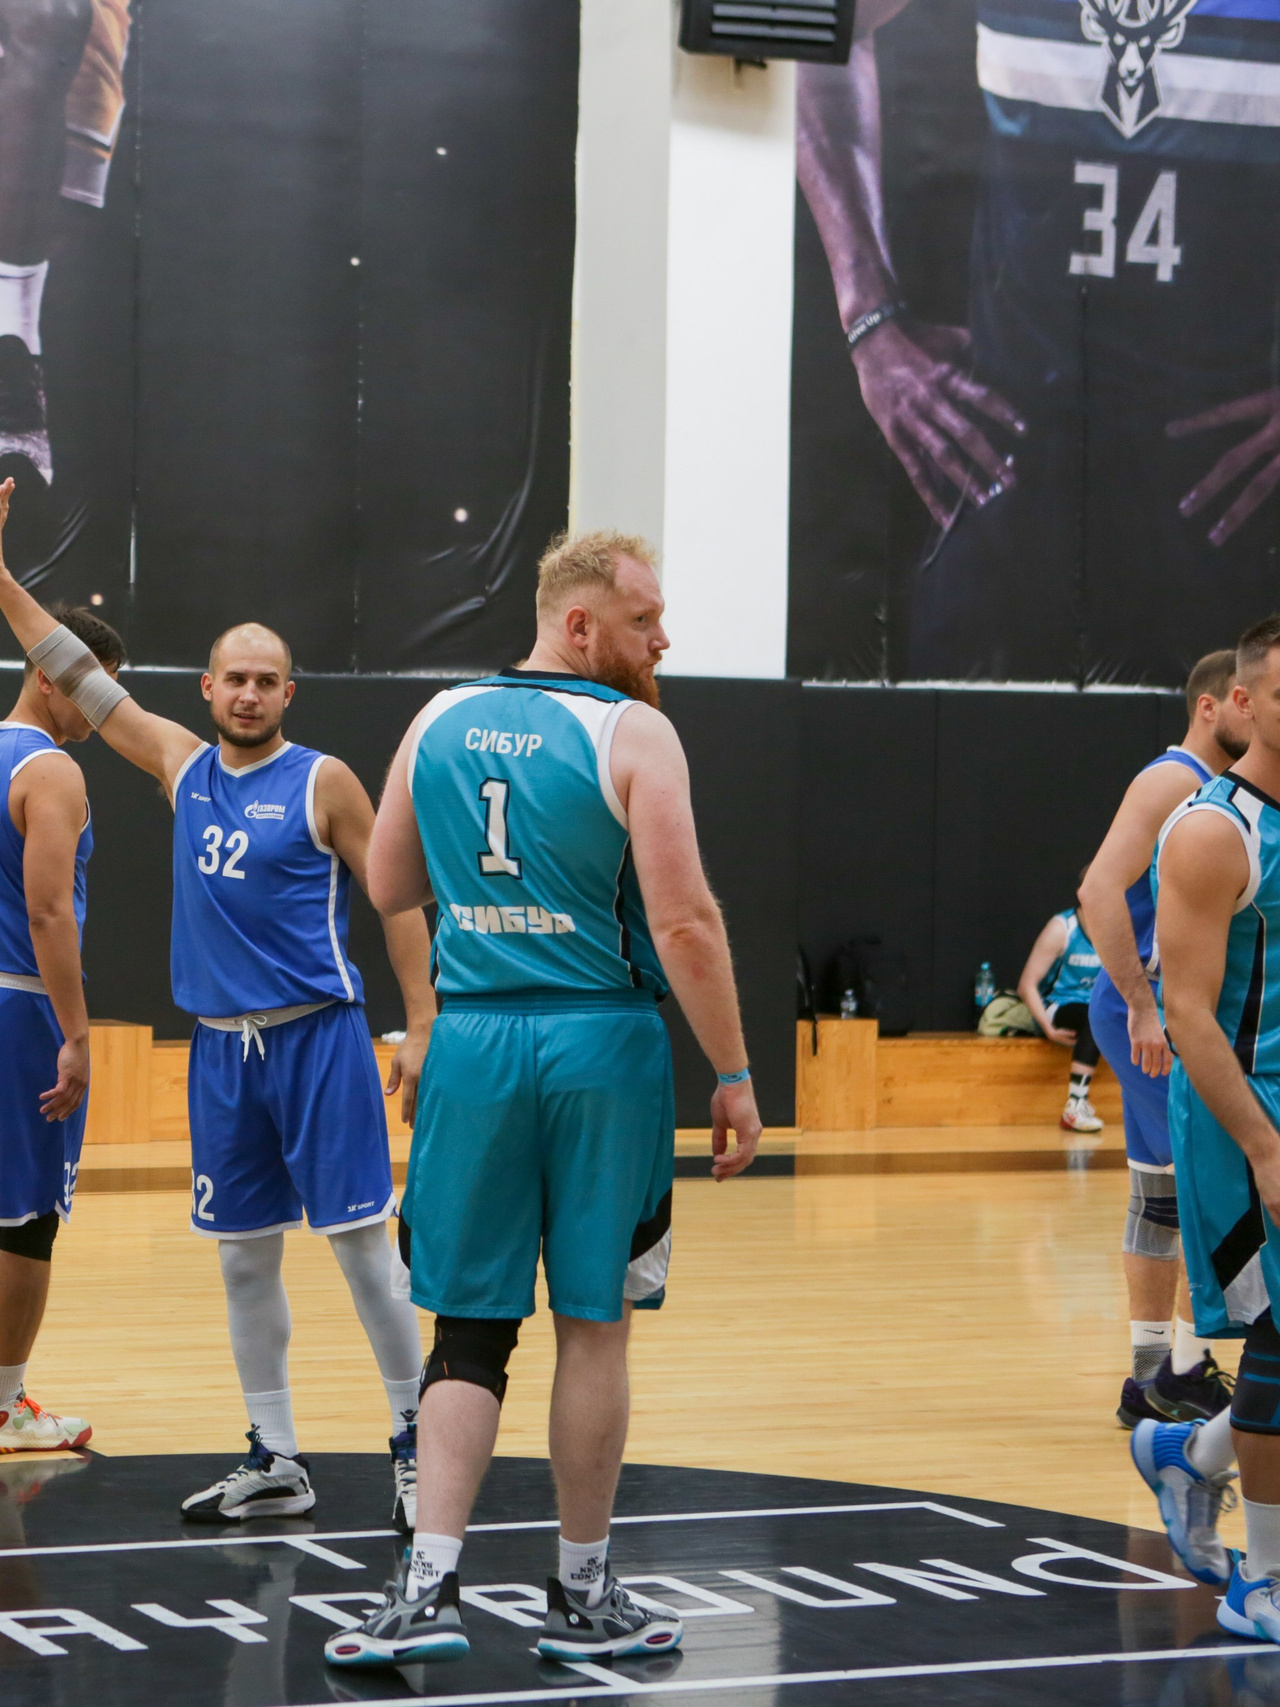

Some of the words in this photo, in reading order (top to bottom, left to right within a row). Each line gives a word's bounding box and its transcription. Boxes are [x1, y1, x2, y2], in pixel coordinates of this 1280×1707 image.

[1069, 161, 1182, 281] 34
[464, 727, 543, 757] СИБУР
[197, 825, 249, 880] 32
[477, 776, 523, 880] 1
[449, 903, 576, 935] СИБУР
[191, 1168, 215, 1222] 2
